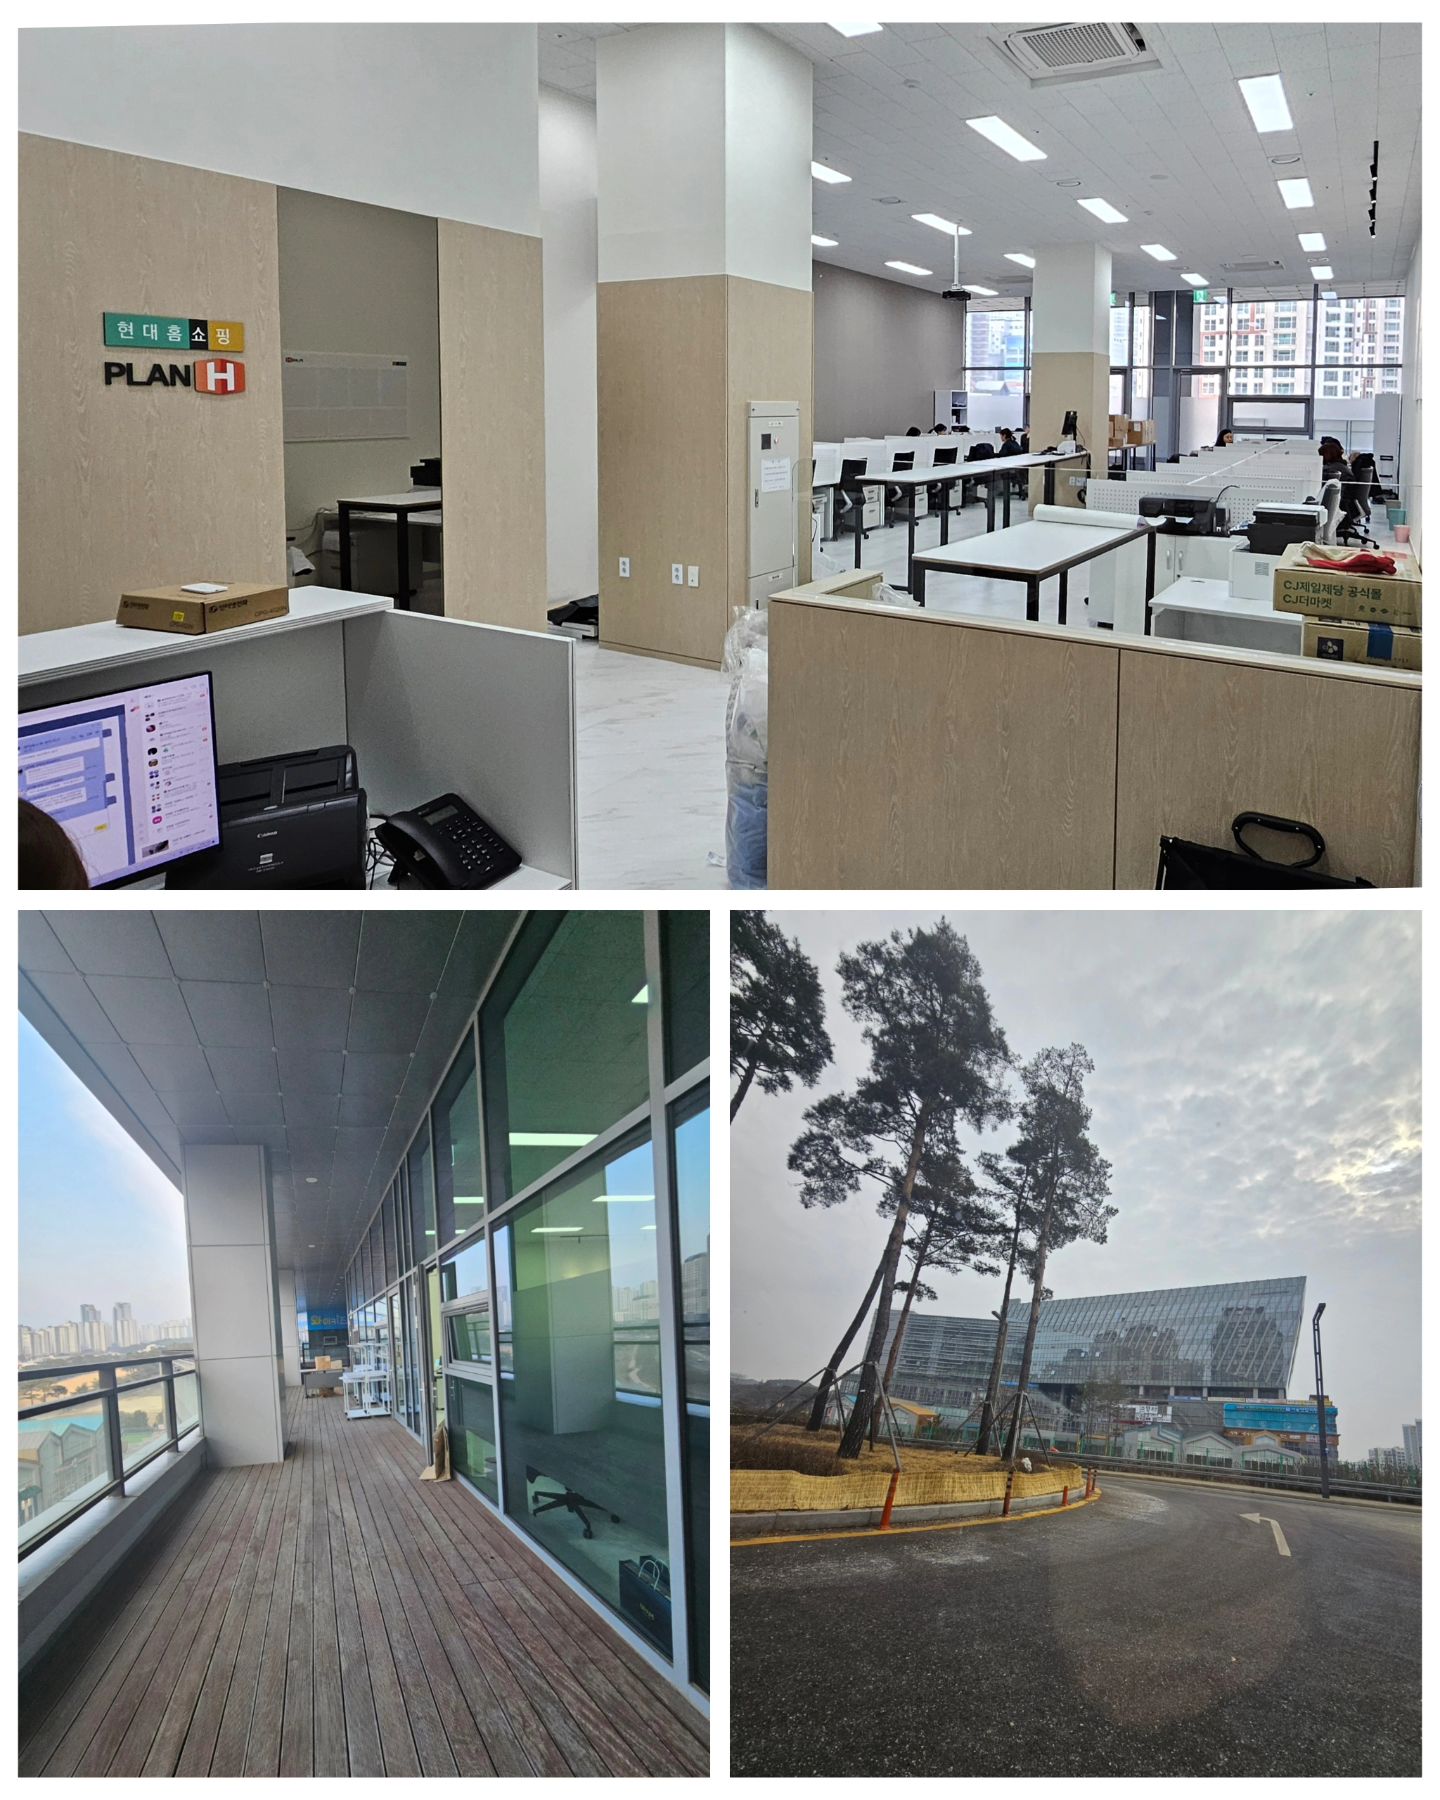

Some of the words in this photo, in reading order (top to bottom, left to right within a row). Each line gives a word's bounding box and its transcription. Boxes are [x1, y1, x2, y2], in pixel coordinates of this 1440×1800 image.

[117, 321, 230, 345] 현대홈쇼핑
[104, 362, 191, 386] PLAN
[206, 361, 235, 391] H
[1283, 580, 1345, 597] CJ제일제당
[1347, 585, 1382, 600] 공식몰
[1282, 594, 1332, 609] CJ더마켓
